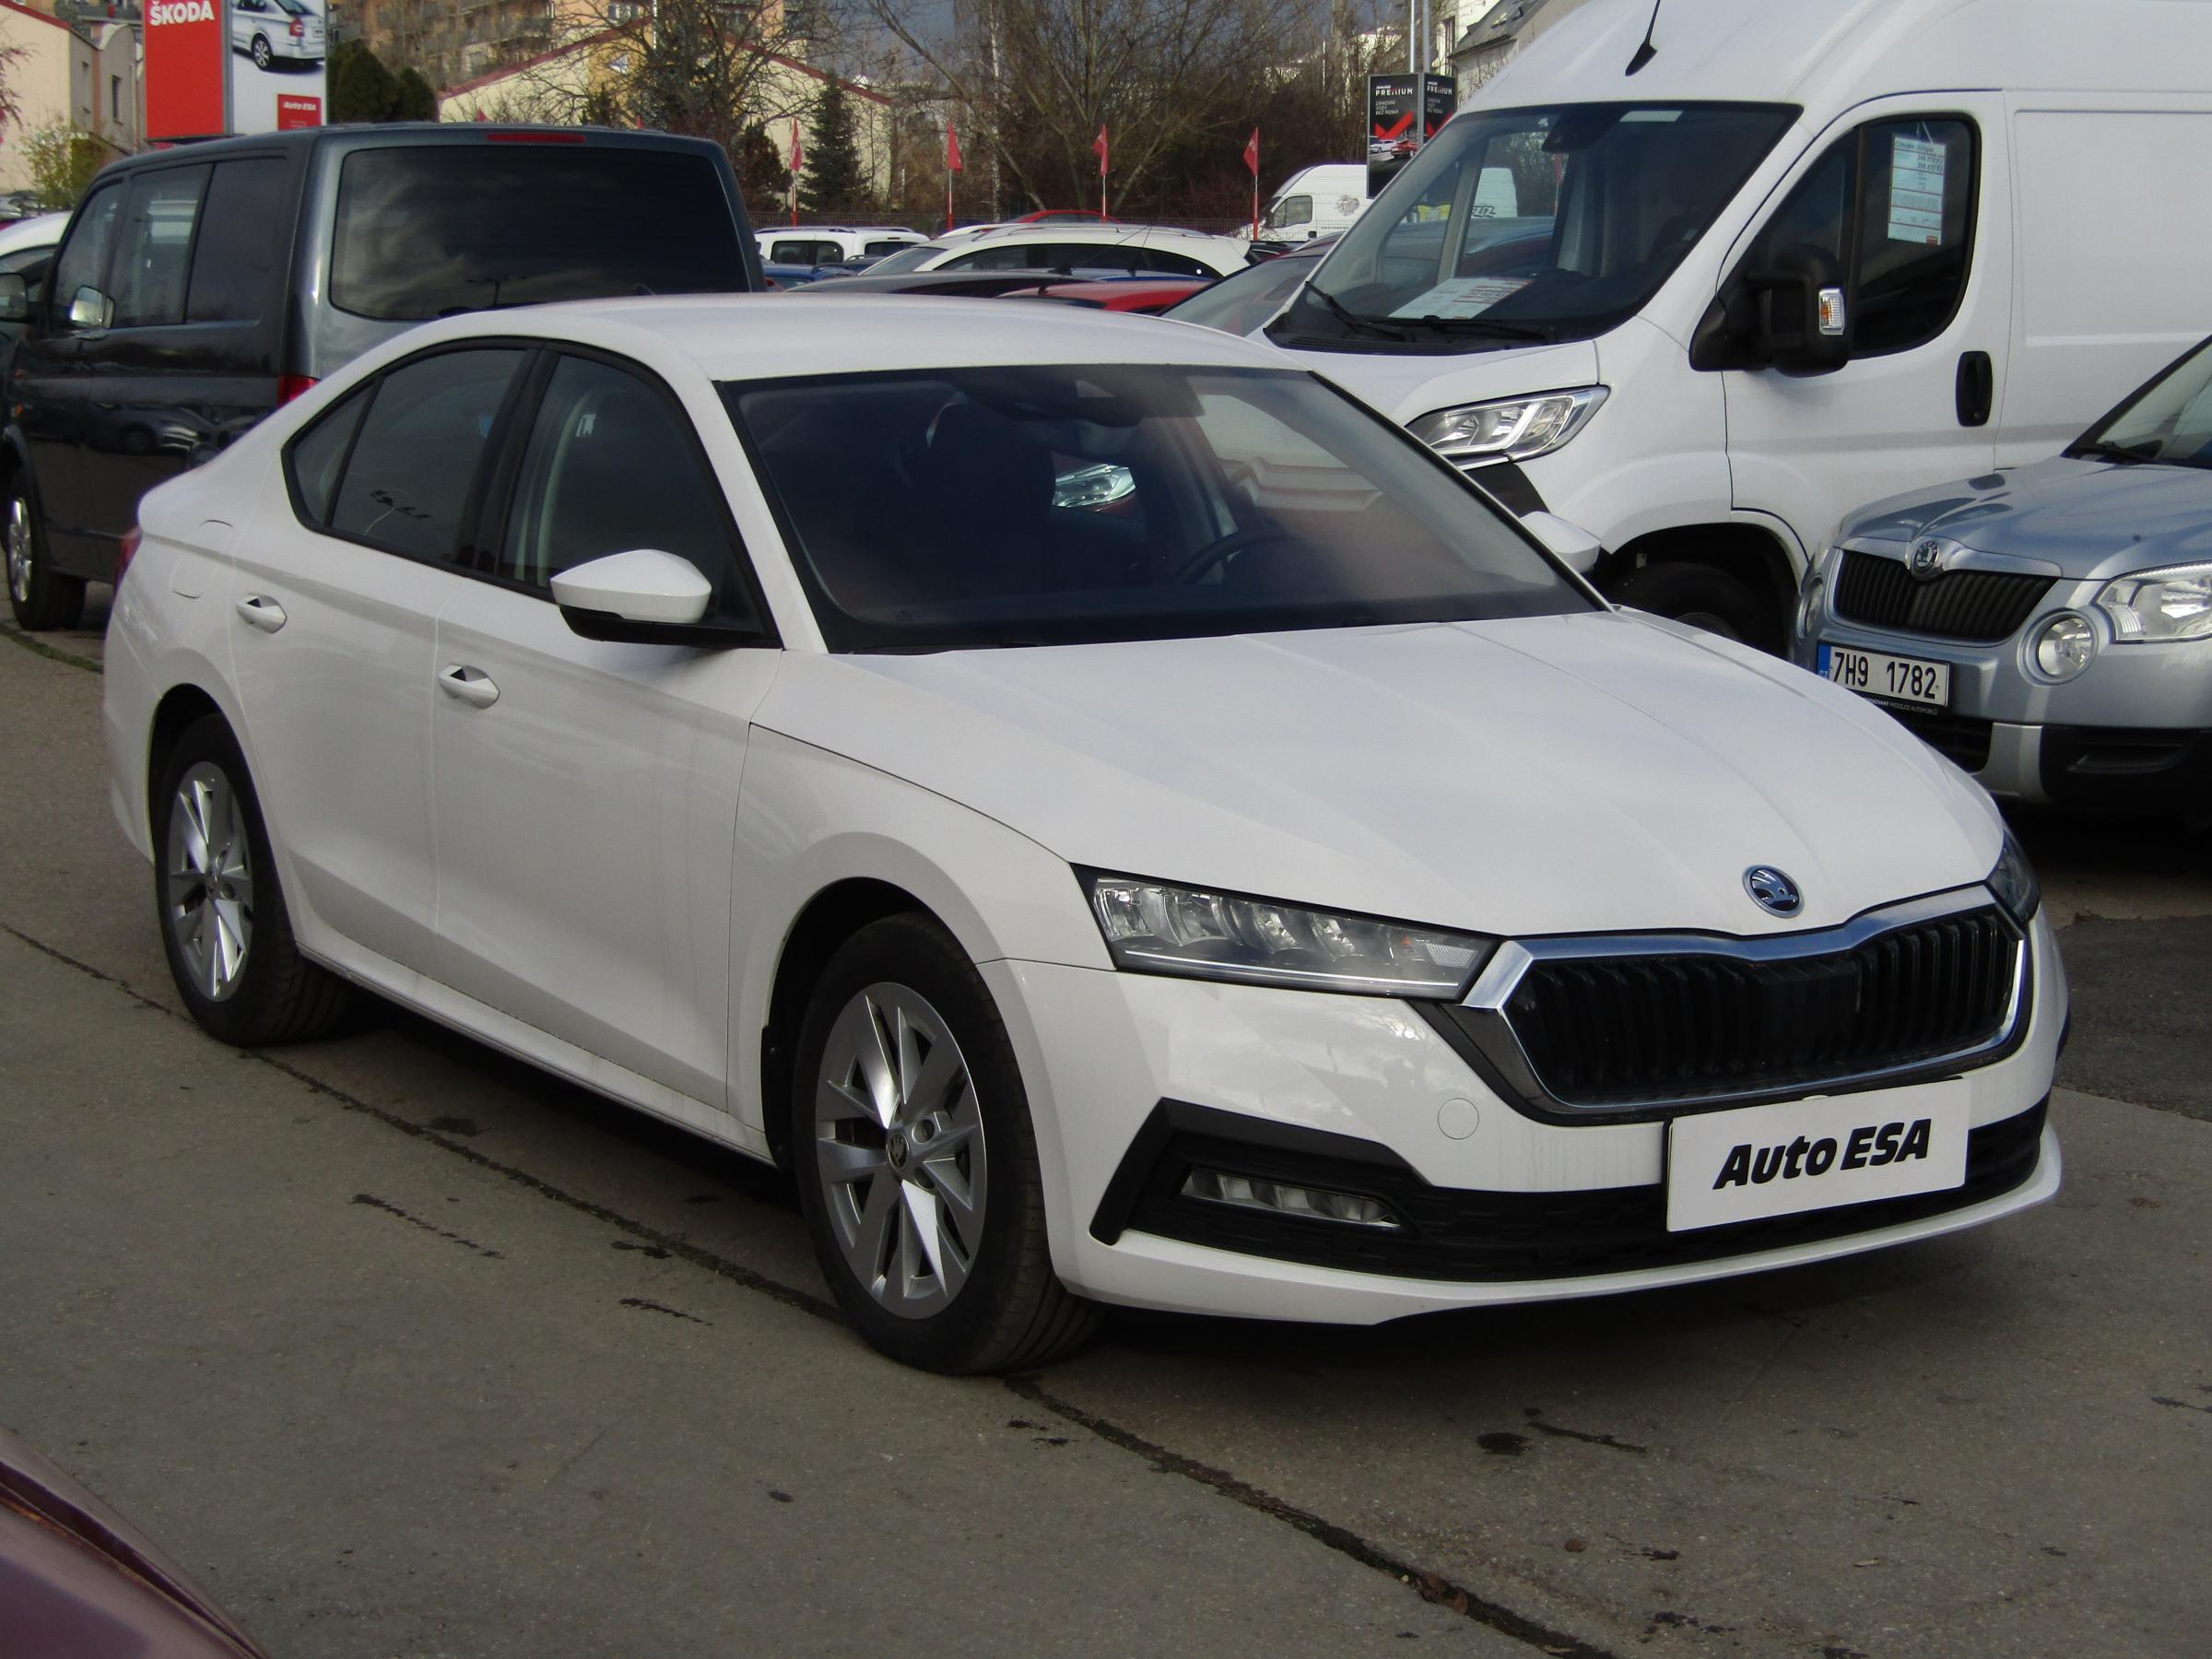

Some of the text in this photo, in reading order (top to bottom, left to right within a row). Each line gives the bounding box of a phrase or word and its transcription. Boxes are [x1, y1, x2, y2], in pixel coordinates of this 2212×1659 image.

[150, 0, 215, 26] ŠKODA
[1833, 652, 1936, 700] 7H9 1782
[1712, 1118, 1932, 1190] Auto ESA
